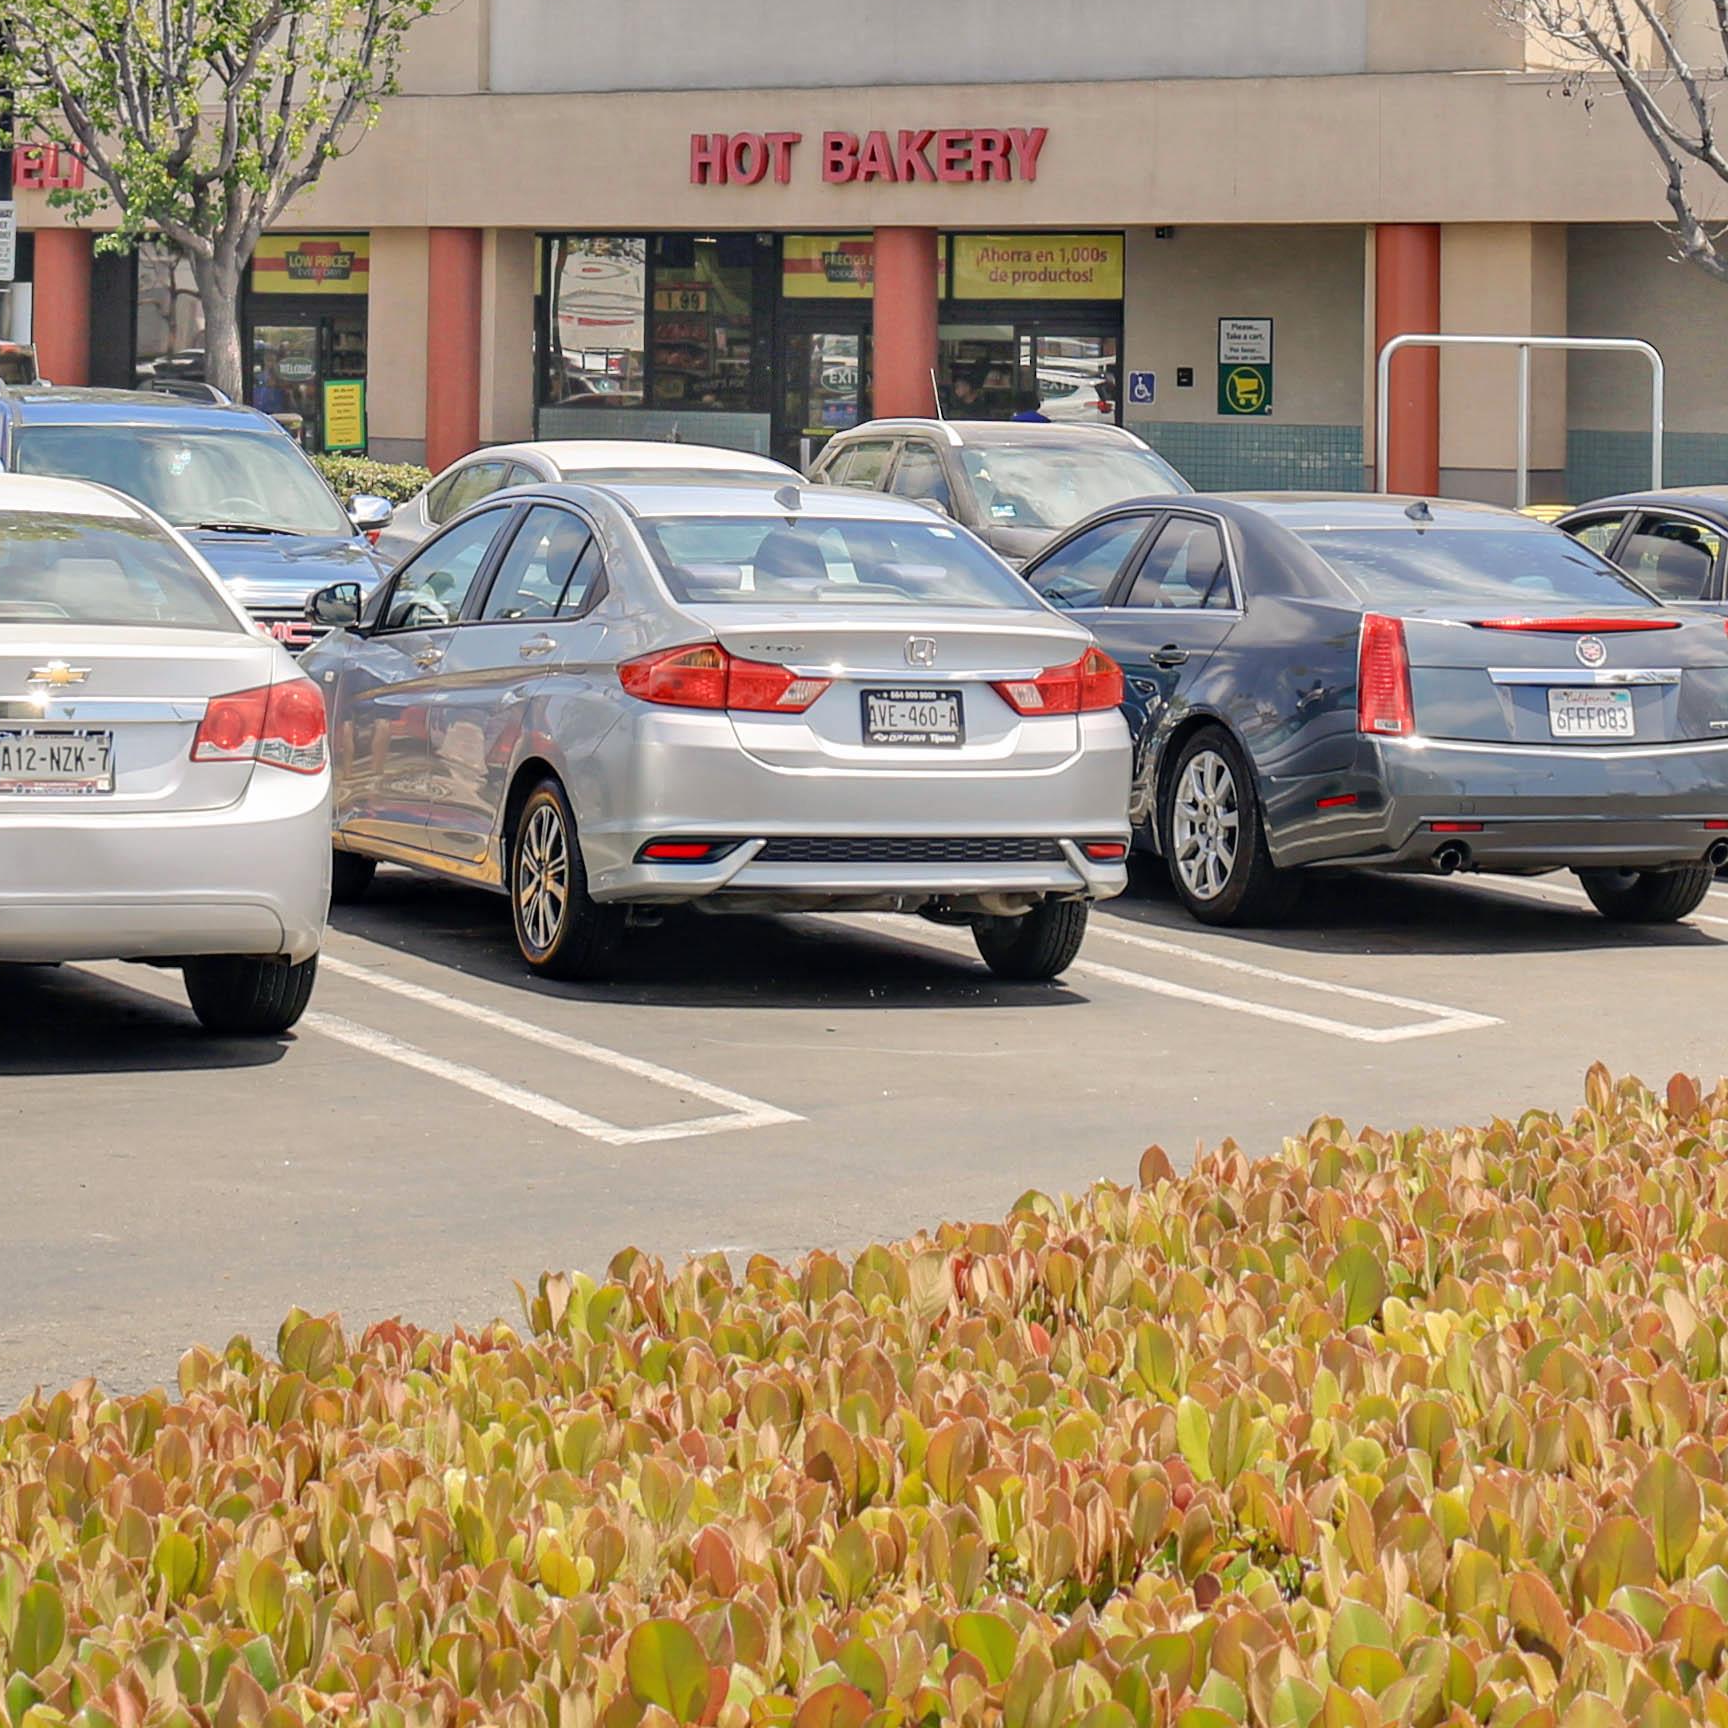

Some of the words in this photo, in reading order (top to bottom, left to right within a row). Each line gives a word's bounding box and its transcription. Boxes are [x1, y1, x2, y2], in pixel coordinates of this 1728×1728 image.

[690, 131, 802, 186] HOT
[822, 127, 1050, 184] BAKERY
[289, 255, 312, 268] LOW
[315, 255, 351, 267] PRICES
[824, 253, 866, 266] PRECIOS
[1036, 250, 1054, 263] en
[1059, 247, 1108, 265] 1,000s
[989, 267, 1008, 282] de
[1012, 267, 1094, 286] productos!
[829, 371, 858, 384] EXIT
[255, 621, 312, 643] MC
[869, 704, 959, 727] AVE-460-A
[1556, 706, 1628, 731] 6FFF083
[1, 746, 109, 772] A12-NZK-7
